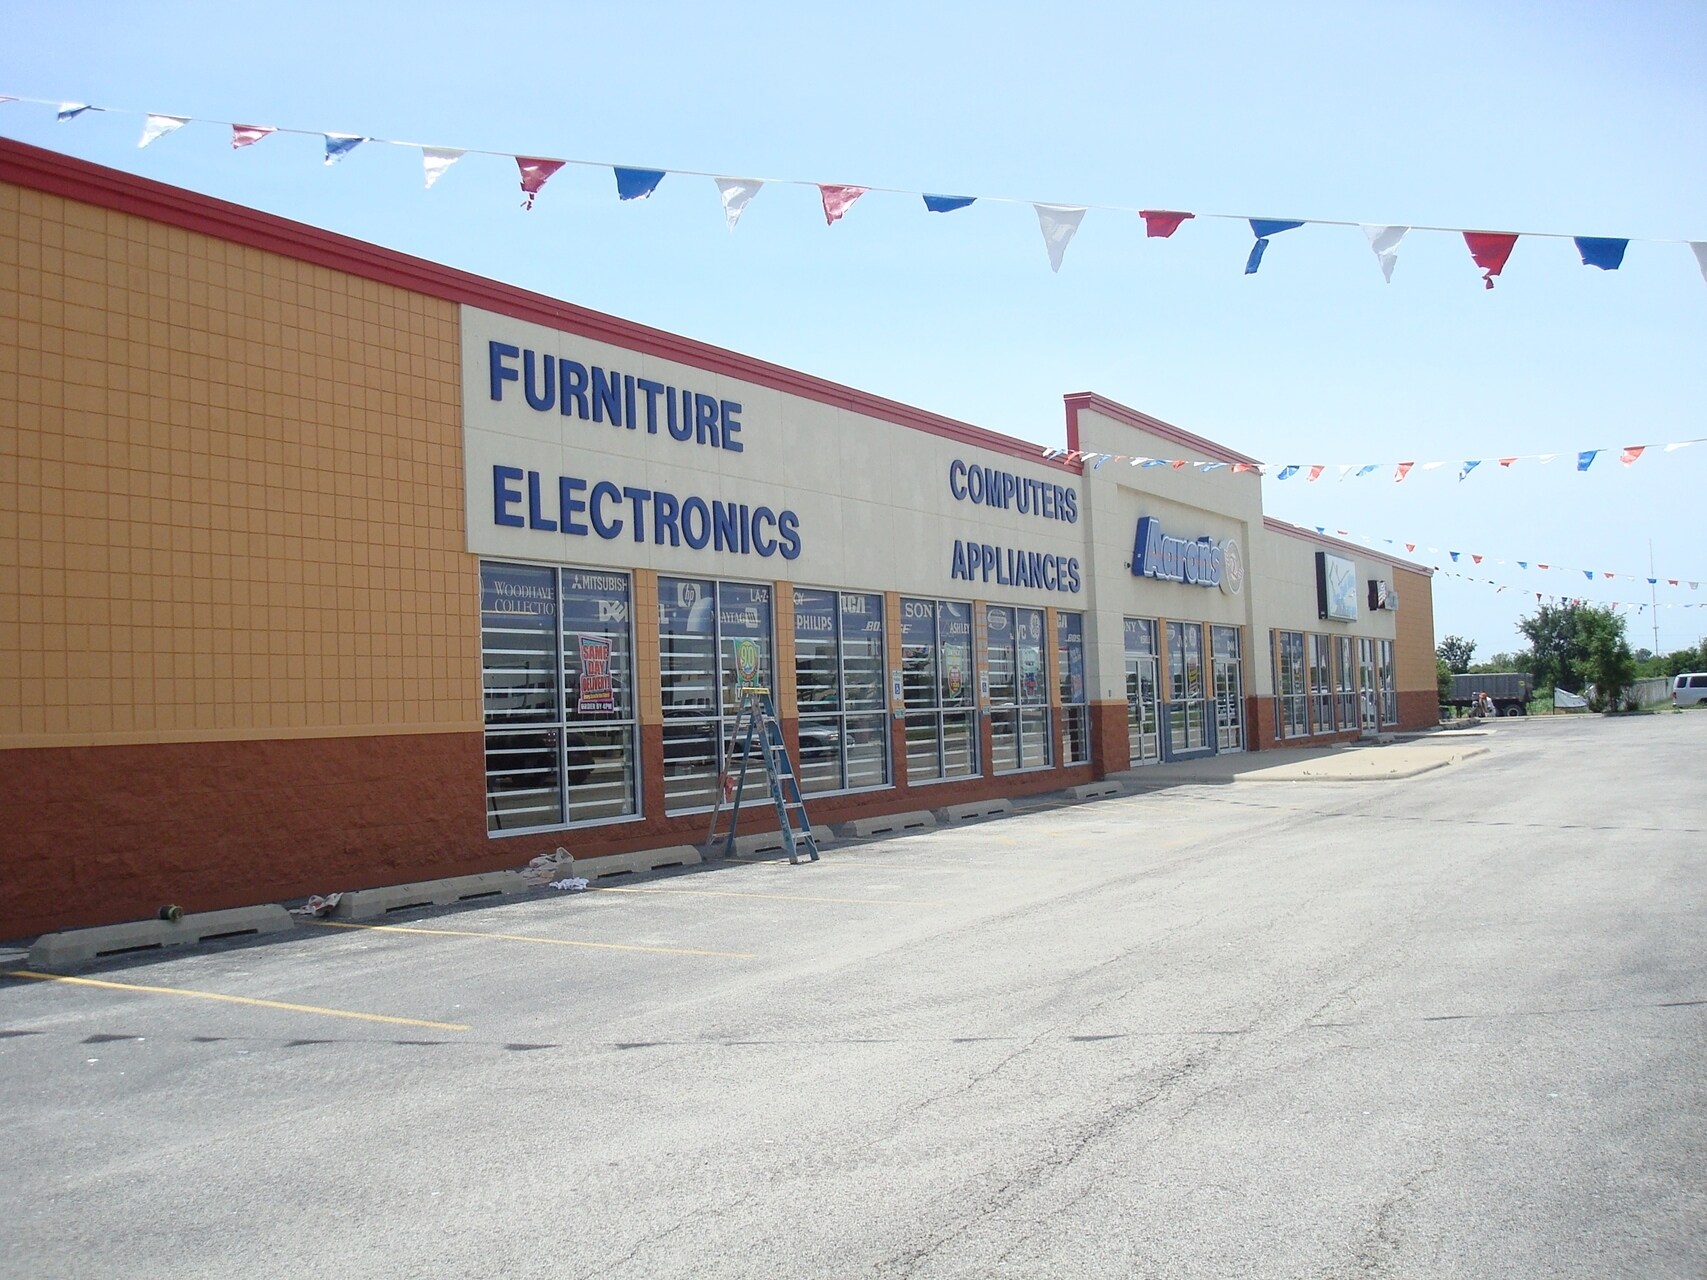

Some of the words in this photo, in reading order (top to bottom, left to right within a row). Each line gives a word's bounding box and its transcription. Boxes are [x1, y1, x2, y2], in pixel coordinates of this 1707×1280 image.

[489, 340, 744, 453] FURNITURE
[493, 464, 801, 560] ELECTRONICS
[950, 459, 1078, 524] COMPUTERS
[951, 539, 1081, 594] APPLIANCES
[1131, 516, 1221, 587] Aaron's
[583, 645, 609, 660] SAME
[797, 614, 833, 631] PHILIPS
[588, 660, 605, 675] DAY
